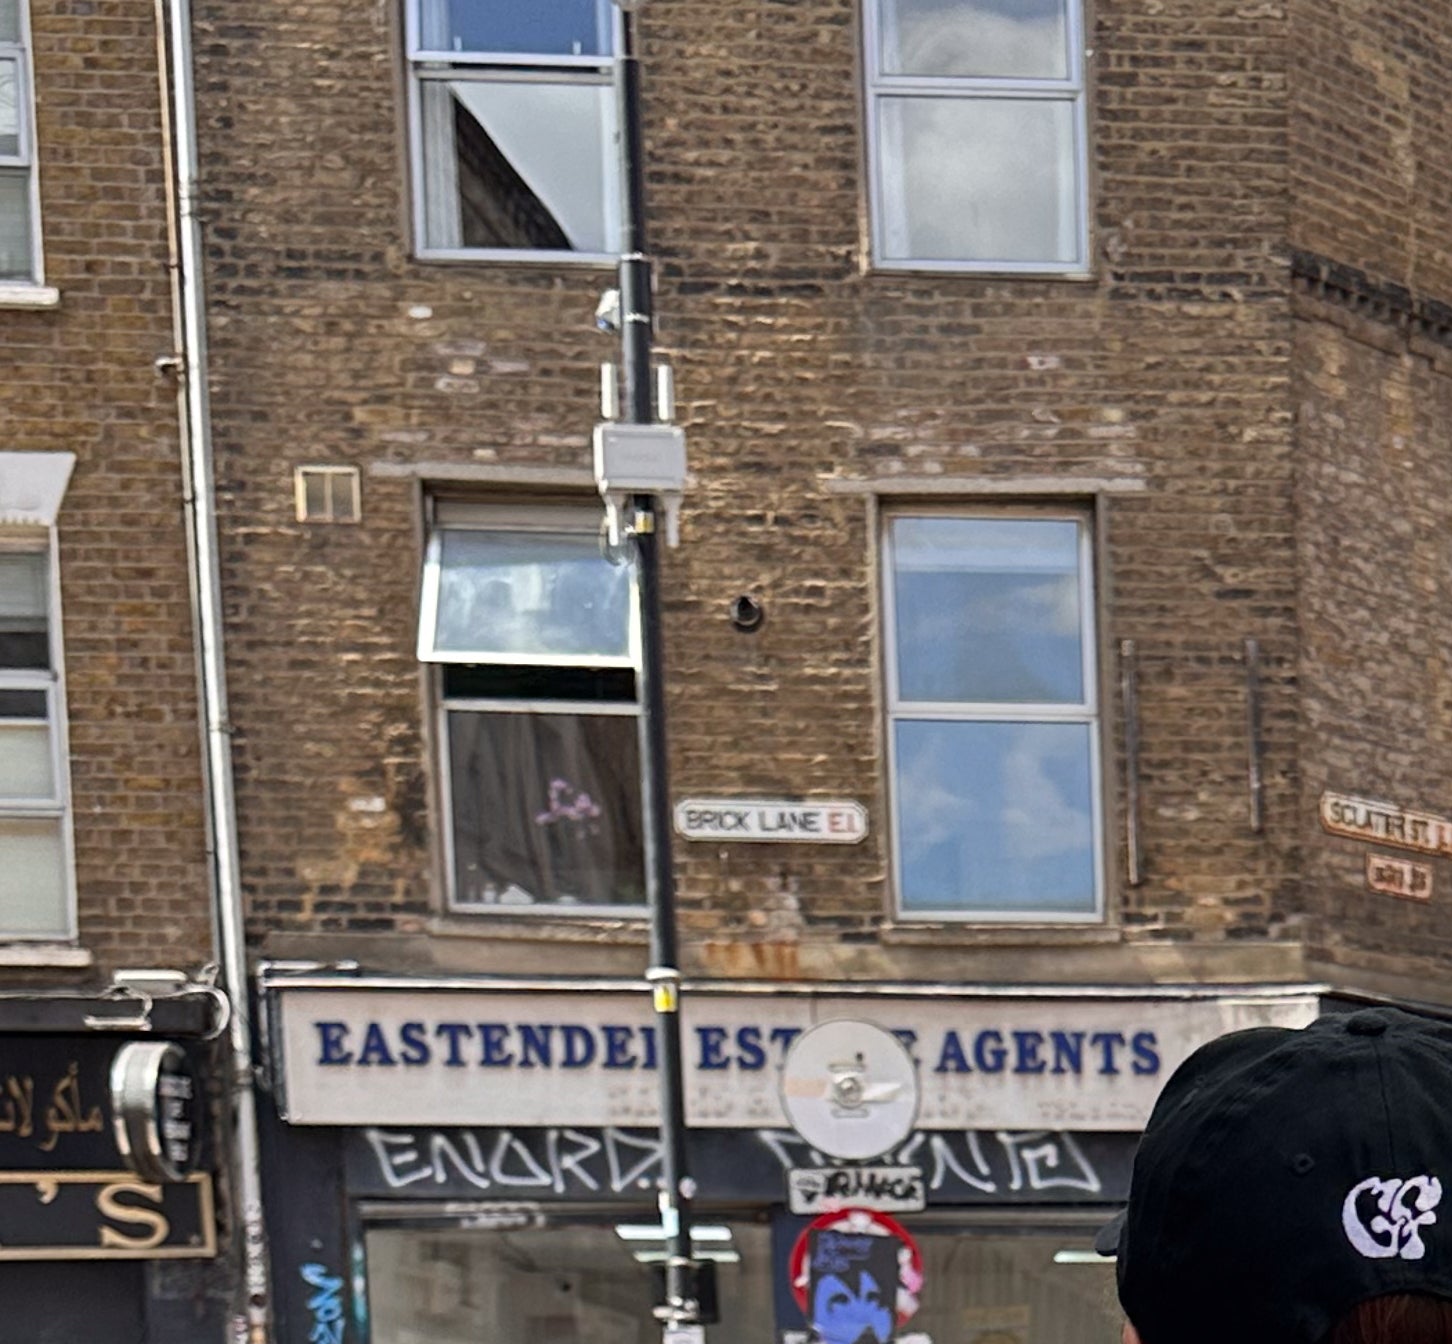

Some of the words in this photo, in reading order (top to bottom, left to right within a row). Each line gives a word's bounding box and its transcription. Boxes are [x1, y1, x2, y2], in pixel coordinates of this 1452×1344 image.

[686, 809, 751, 832] BRICK
[757, 811, 822, 833] LANE
[934, 1028, 1162, 1077] AGENTS
